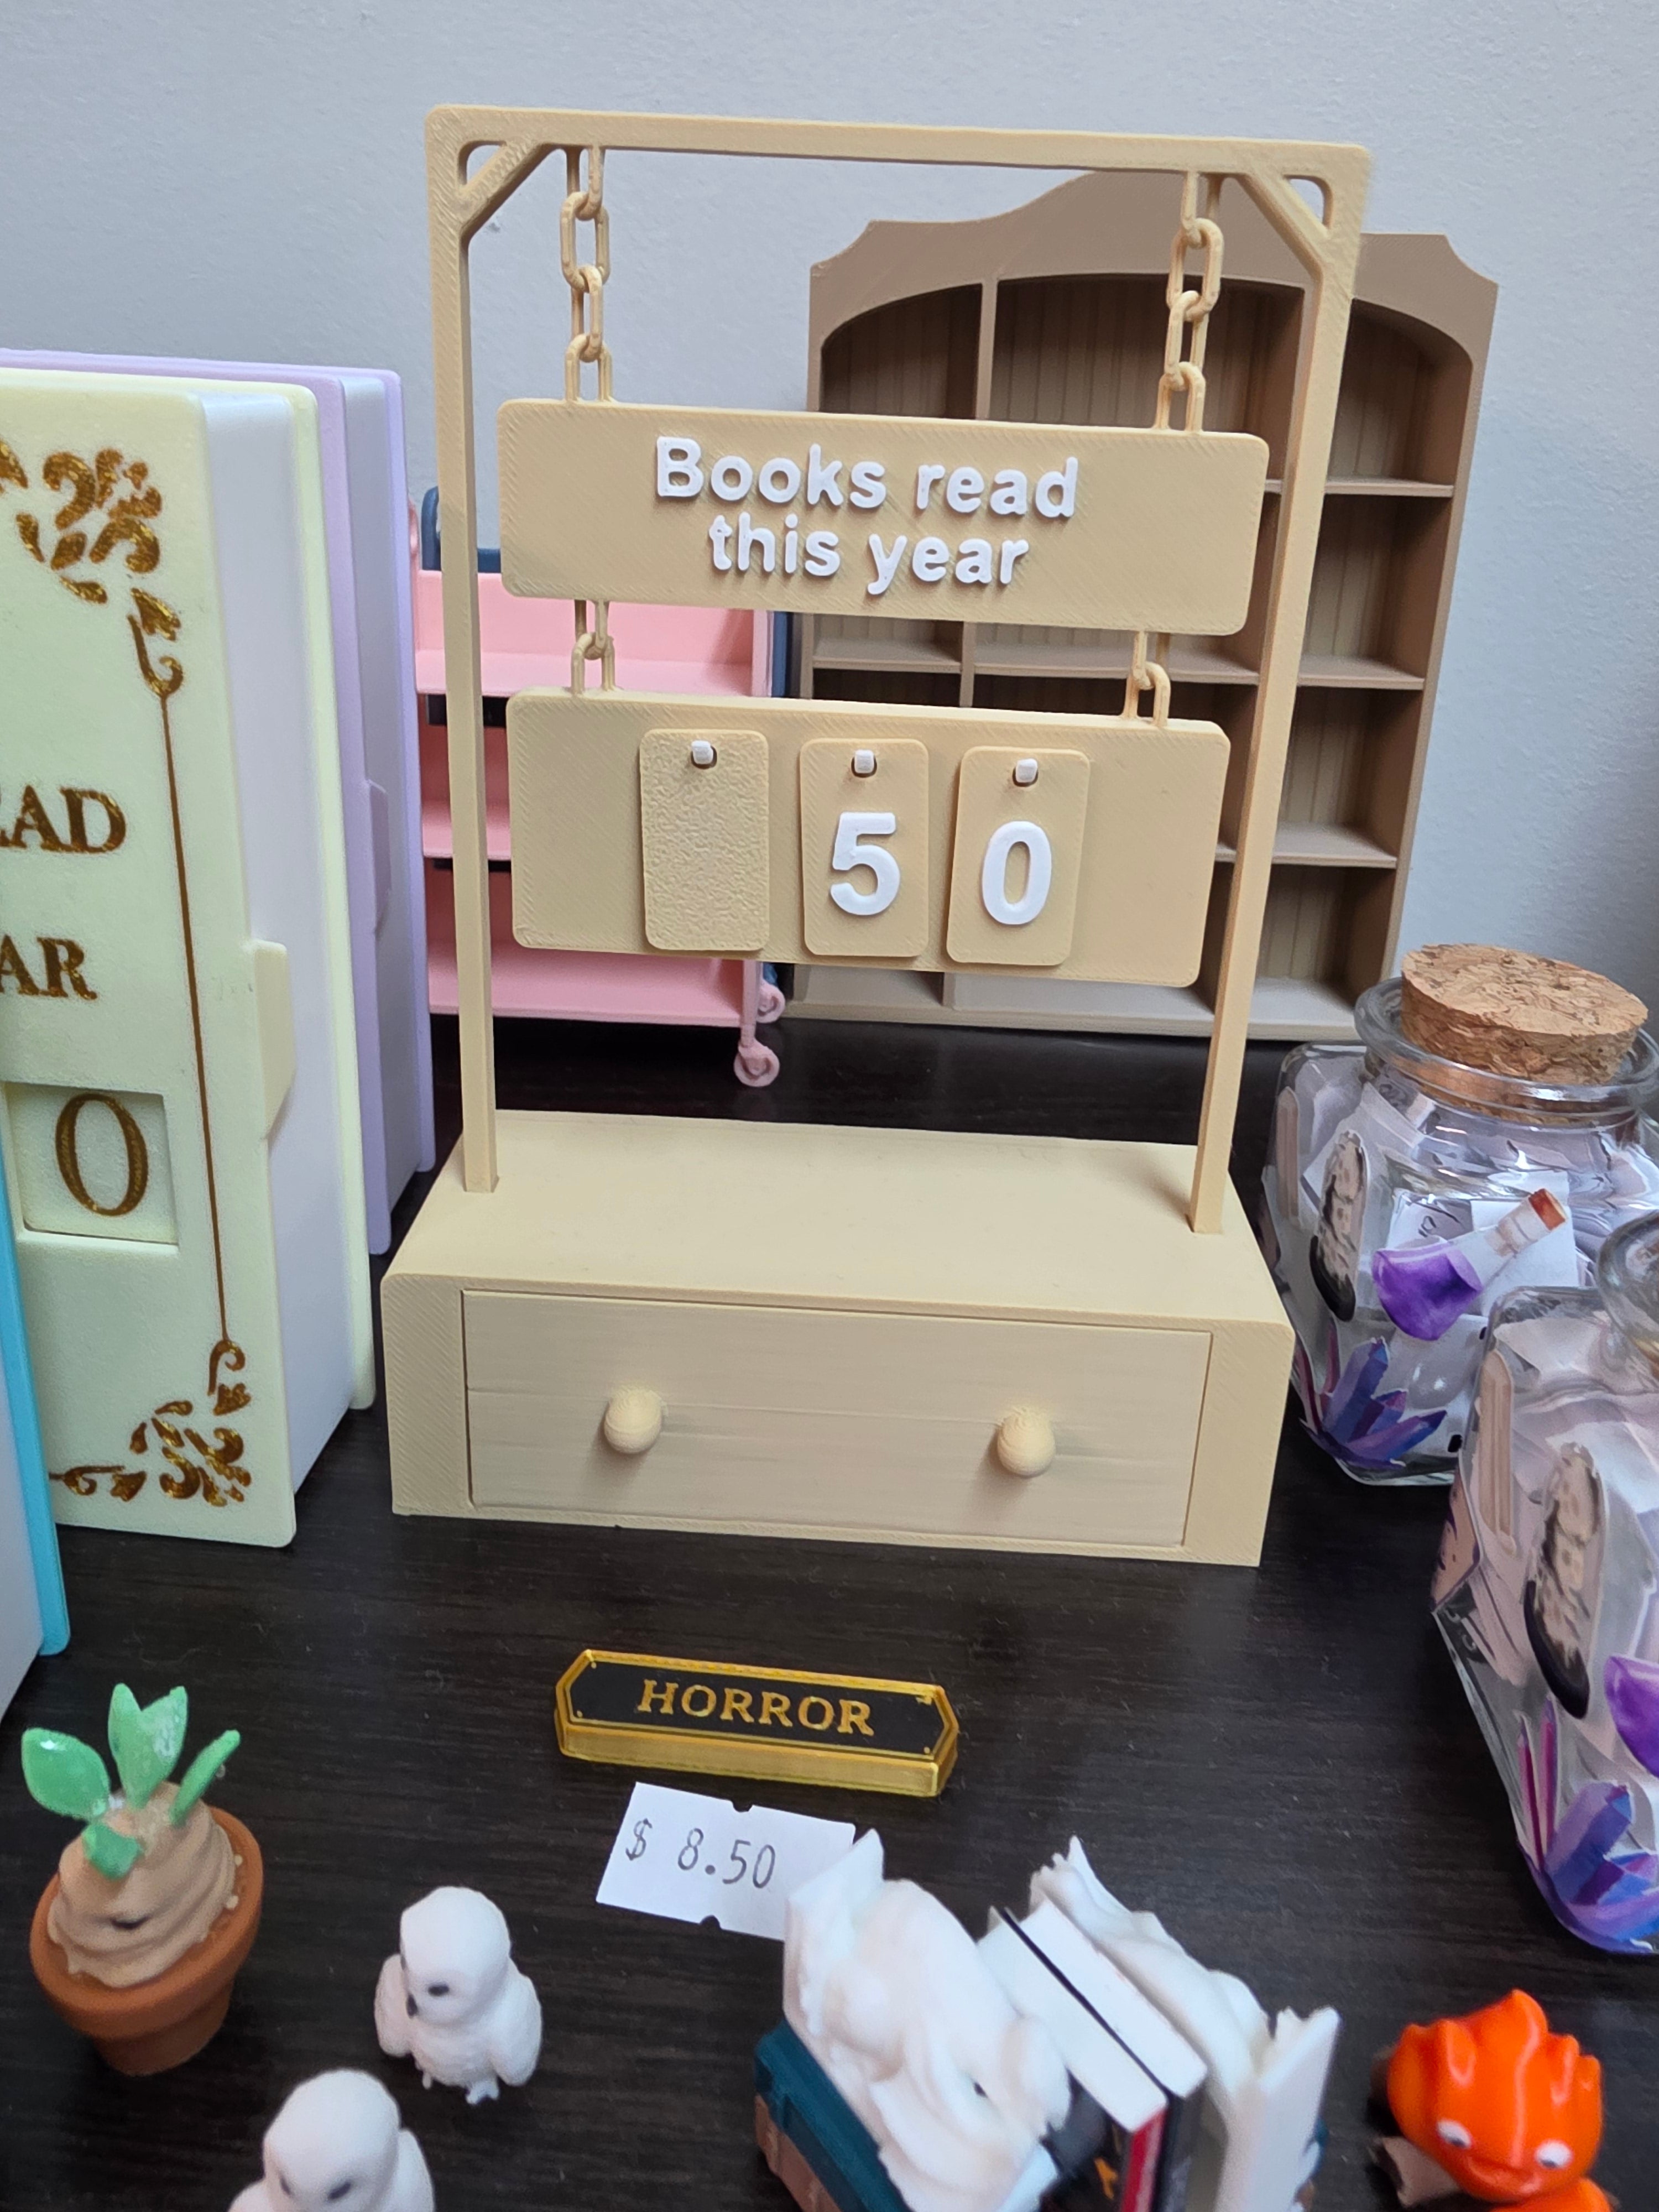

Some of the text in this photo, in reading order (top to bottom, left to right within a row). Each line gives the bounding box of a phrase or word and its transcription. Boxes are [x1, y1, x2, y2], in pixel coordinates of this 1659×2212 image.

[656, 435, 1078, 518] Books read
[708, 512, 1030, 596] this year
[0, 785, 126, 853] AD
[637, 1679, 875, 1737] HORROR
